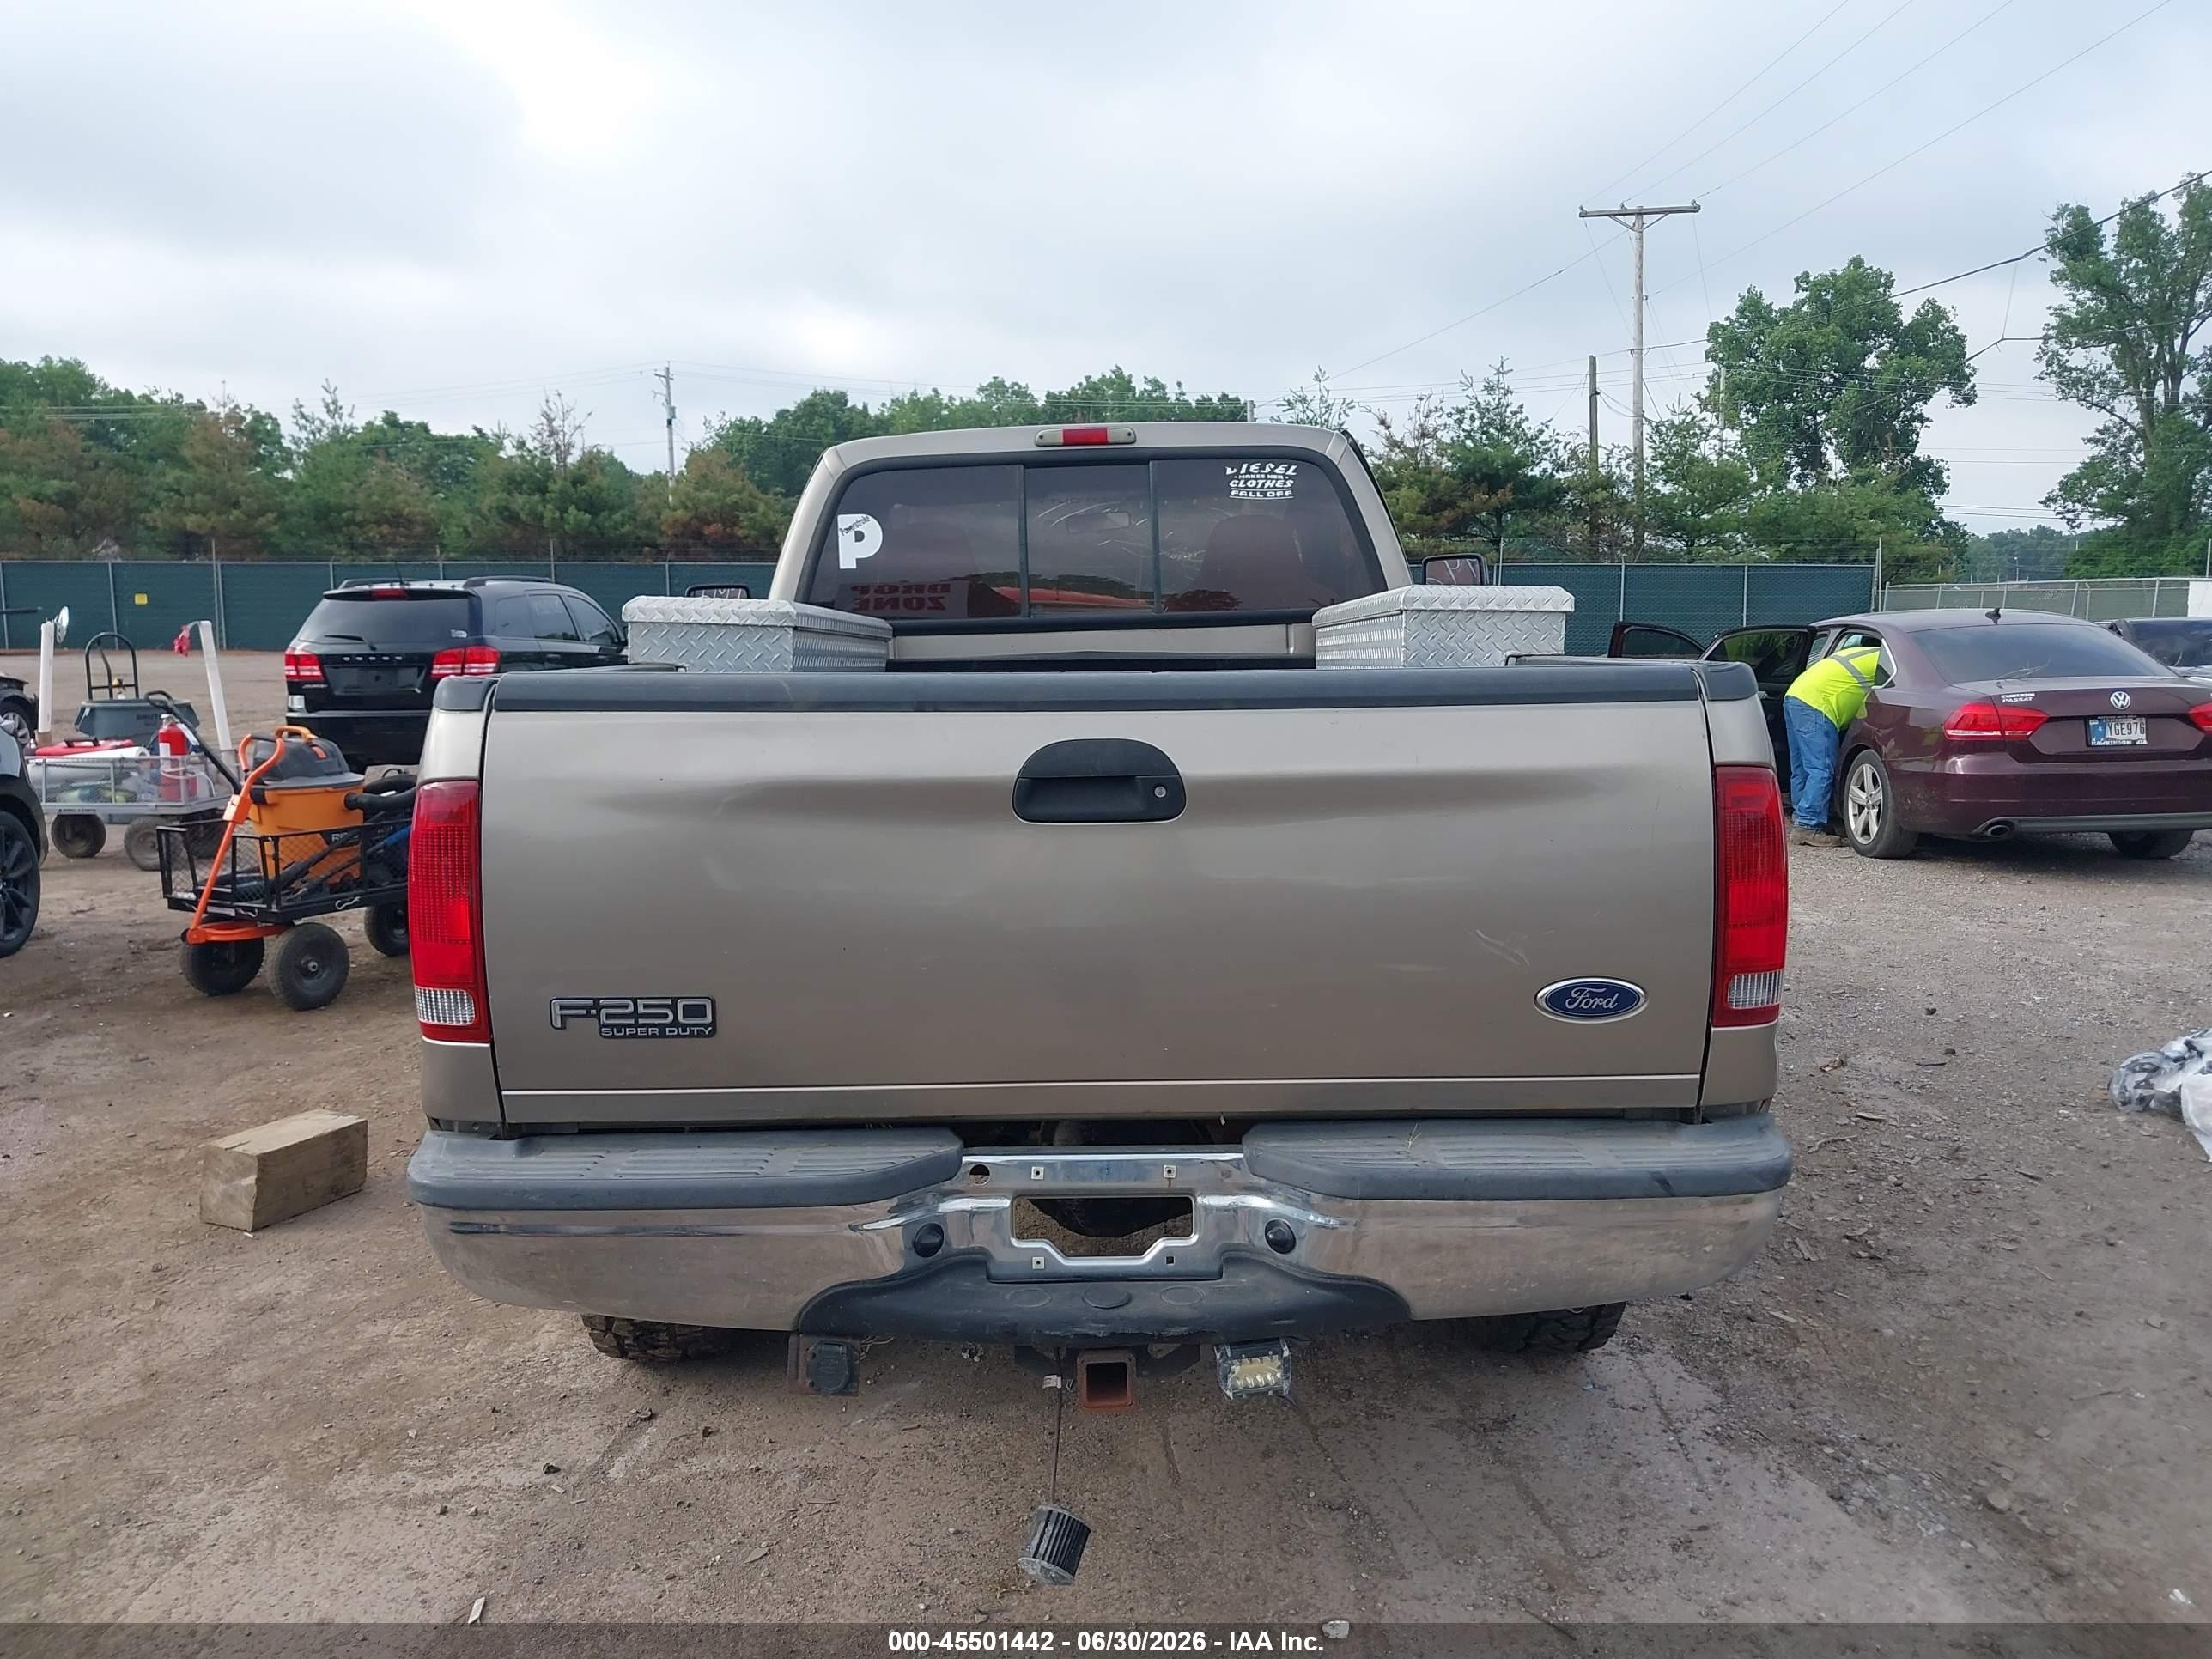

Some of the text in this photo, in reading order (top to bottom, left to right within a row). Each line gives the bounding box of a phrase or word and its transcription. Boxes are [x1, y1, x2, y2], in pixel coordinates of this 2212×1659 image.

[1229, 480, 1294, 489] CLOTHES
[1565, 988, 1620, 1009] Ford
[665, 1027, 713, 1036] DUTY
